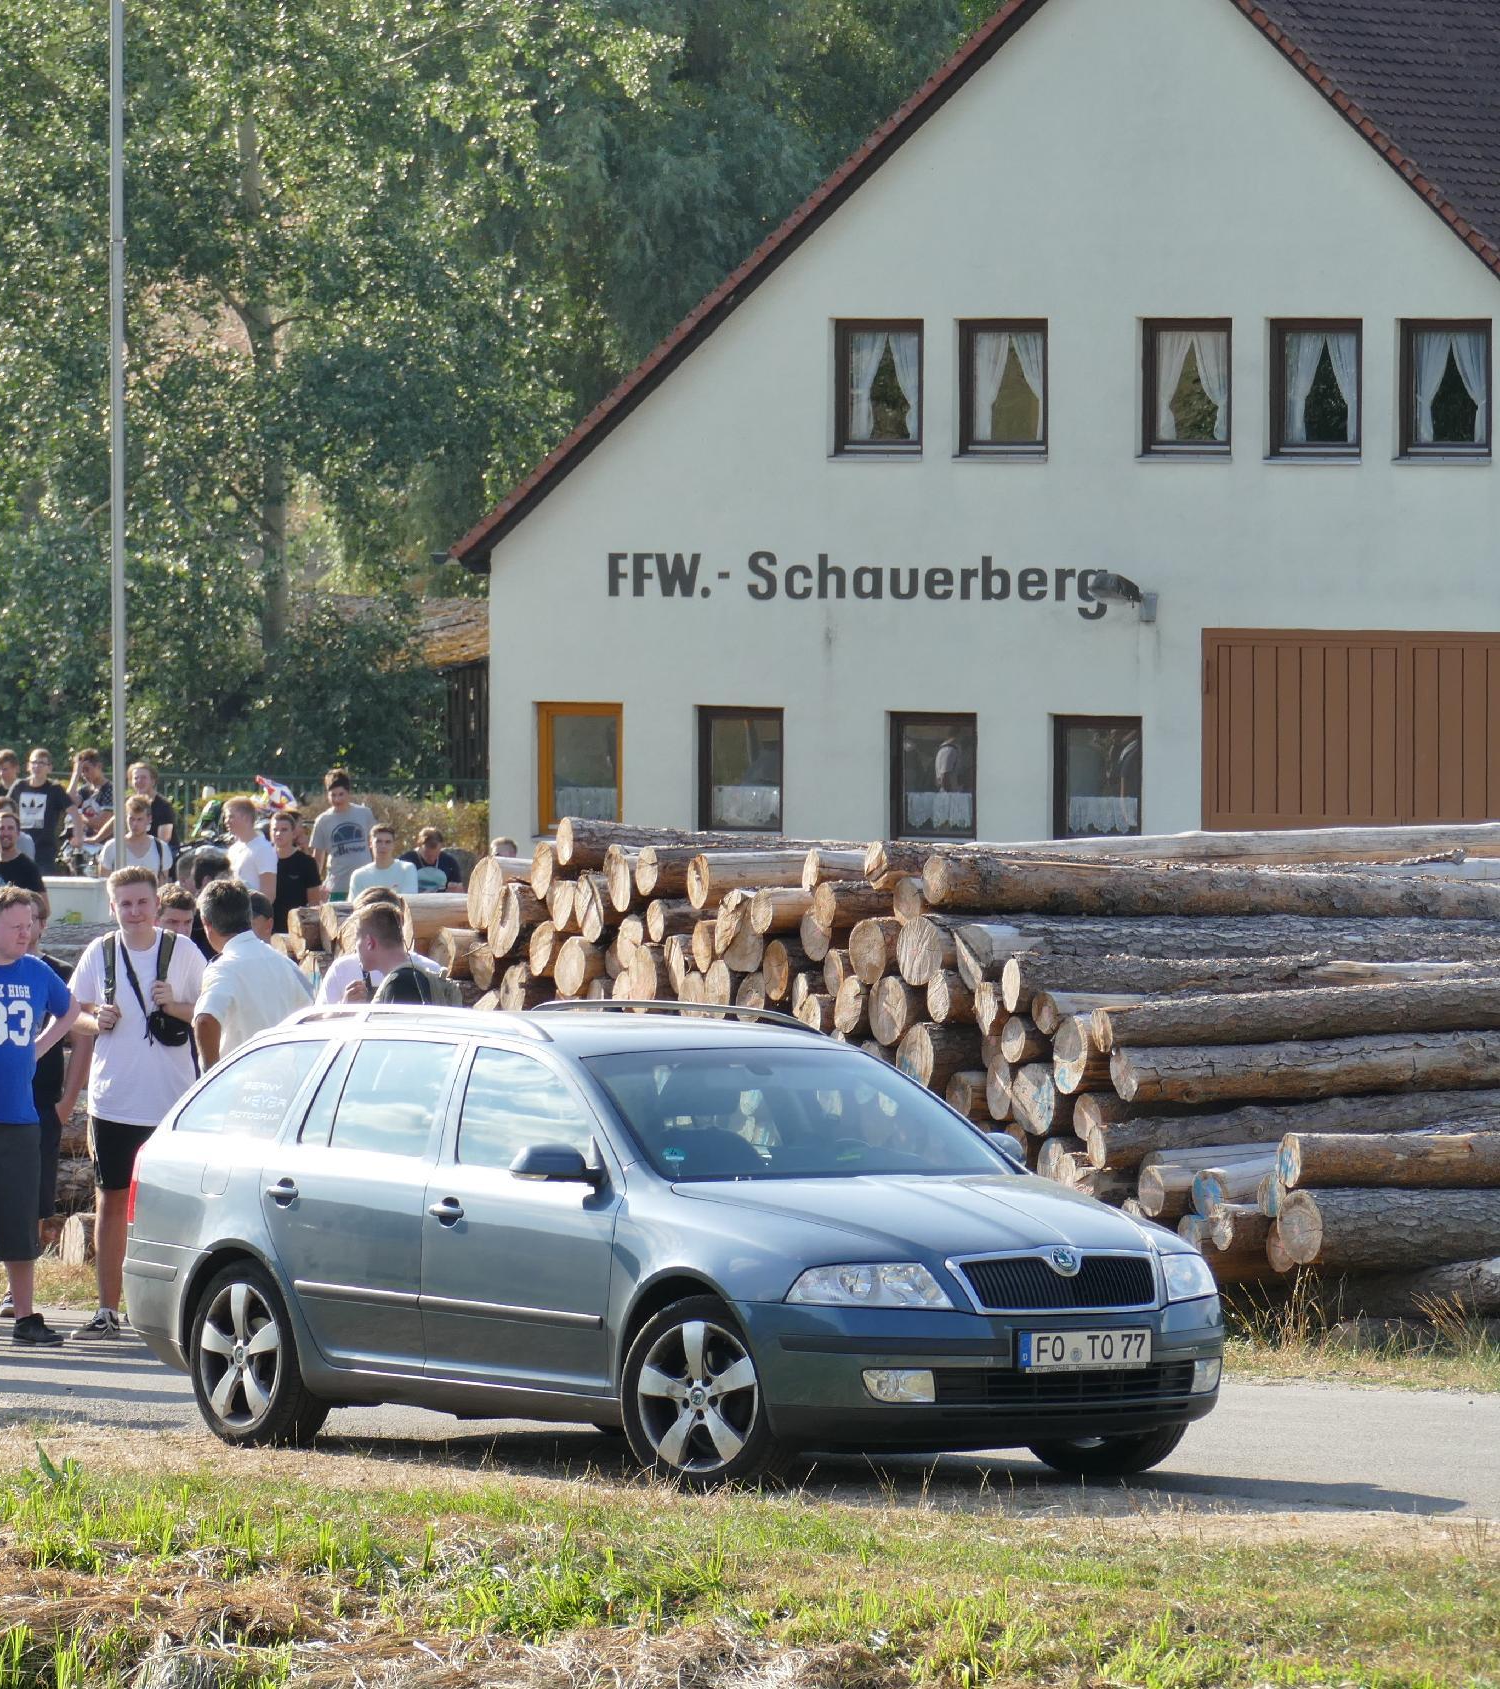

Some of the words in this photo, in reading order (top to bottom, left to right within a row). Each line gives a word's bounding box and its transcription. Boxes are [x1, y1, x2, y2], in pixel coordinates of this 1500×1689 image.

[747, 551, 1108, 620] Schauerberg
[7, 984, 31, 999] HIGH
[242, 1095, 288, 1109] MEYER
[1036, 1335, 1065, 1363] FO
[1087, 1334, 1114, 1361] TO
[1120, 1333, 1146, 1359] 77
